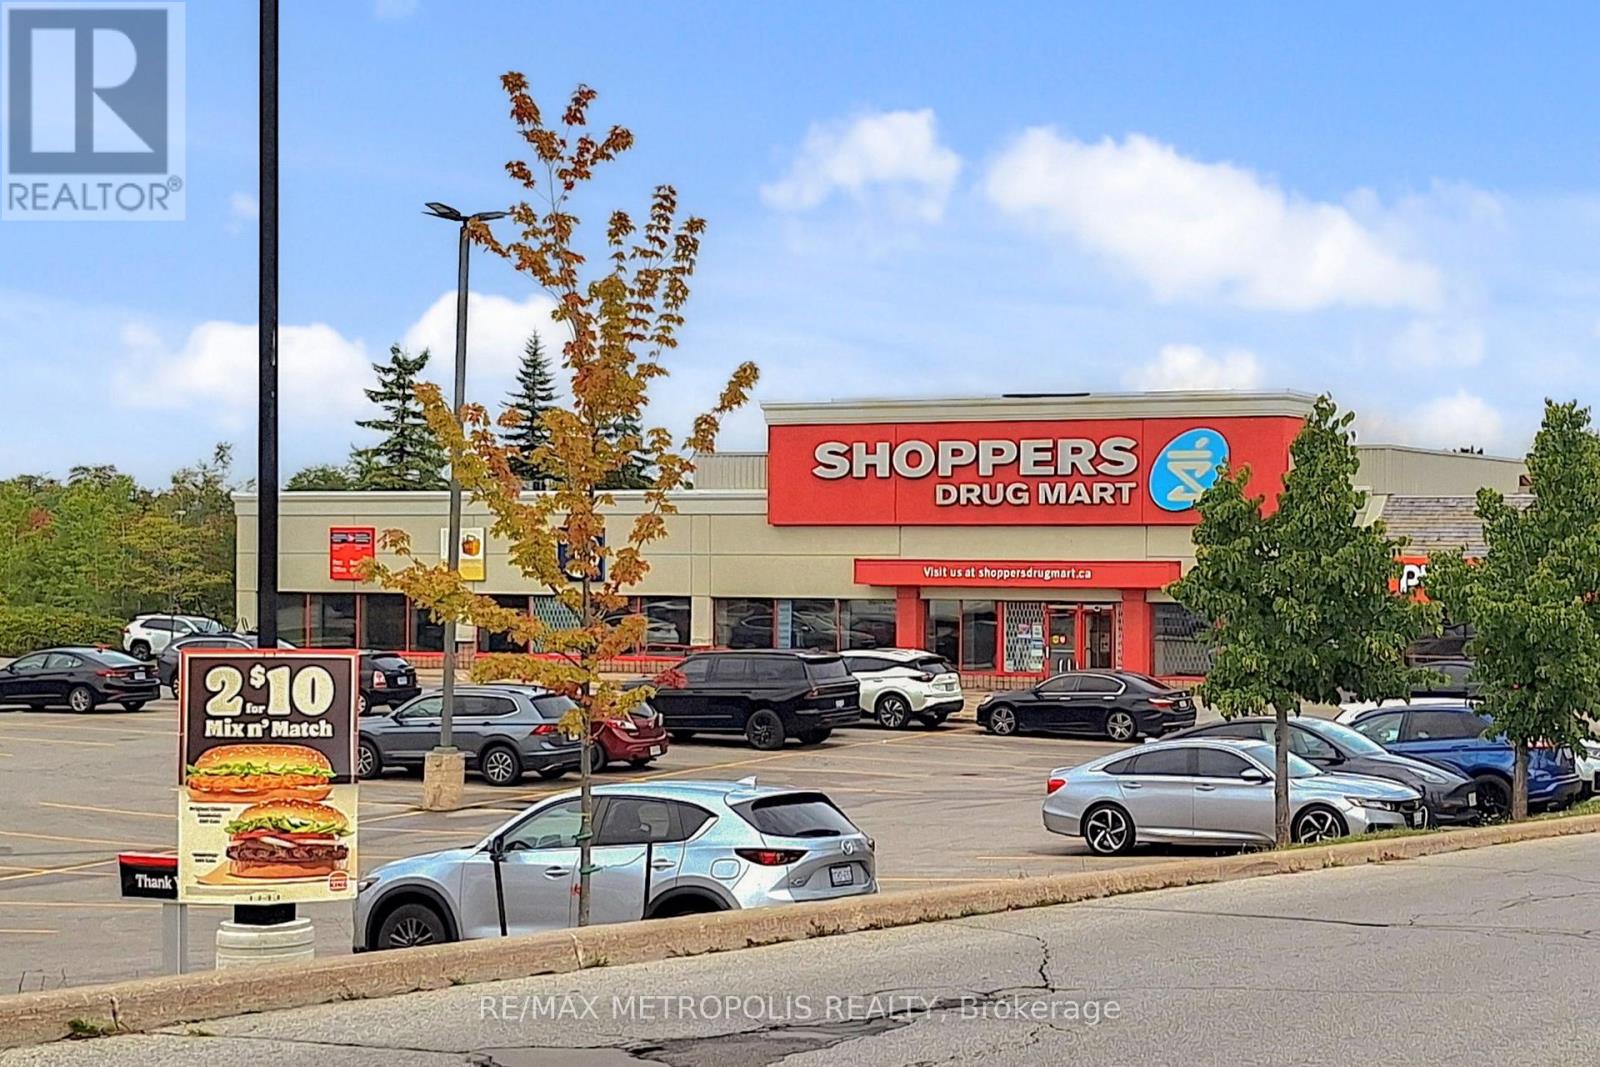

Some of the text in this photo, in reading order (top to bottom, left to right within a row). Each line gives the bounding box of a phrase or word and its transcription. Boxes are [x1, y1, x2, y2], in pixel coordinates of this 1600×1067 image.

[812, 437, 1138, 479] SHOPPERS
[935, 482, 1137, 506] DRUG MART
[923, 566, 1092, 580] Visit us at shoppersdrugmart.ca
[205, 665, 244, 716] 2
[245, 702, 266, 714] for
[204, 717, 245, 738] Mix
[270, 718, 333, 738] Match
[135, 873, 173, 890] Thank
